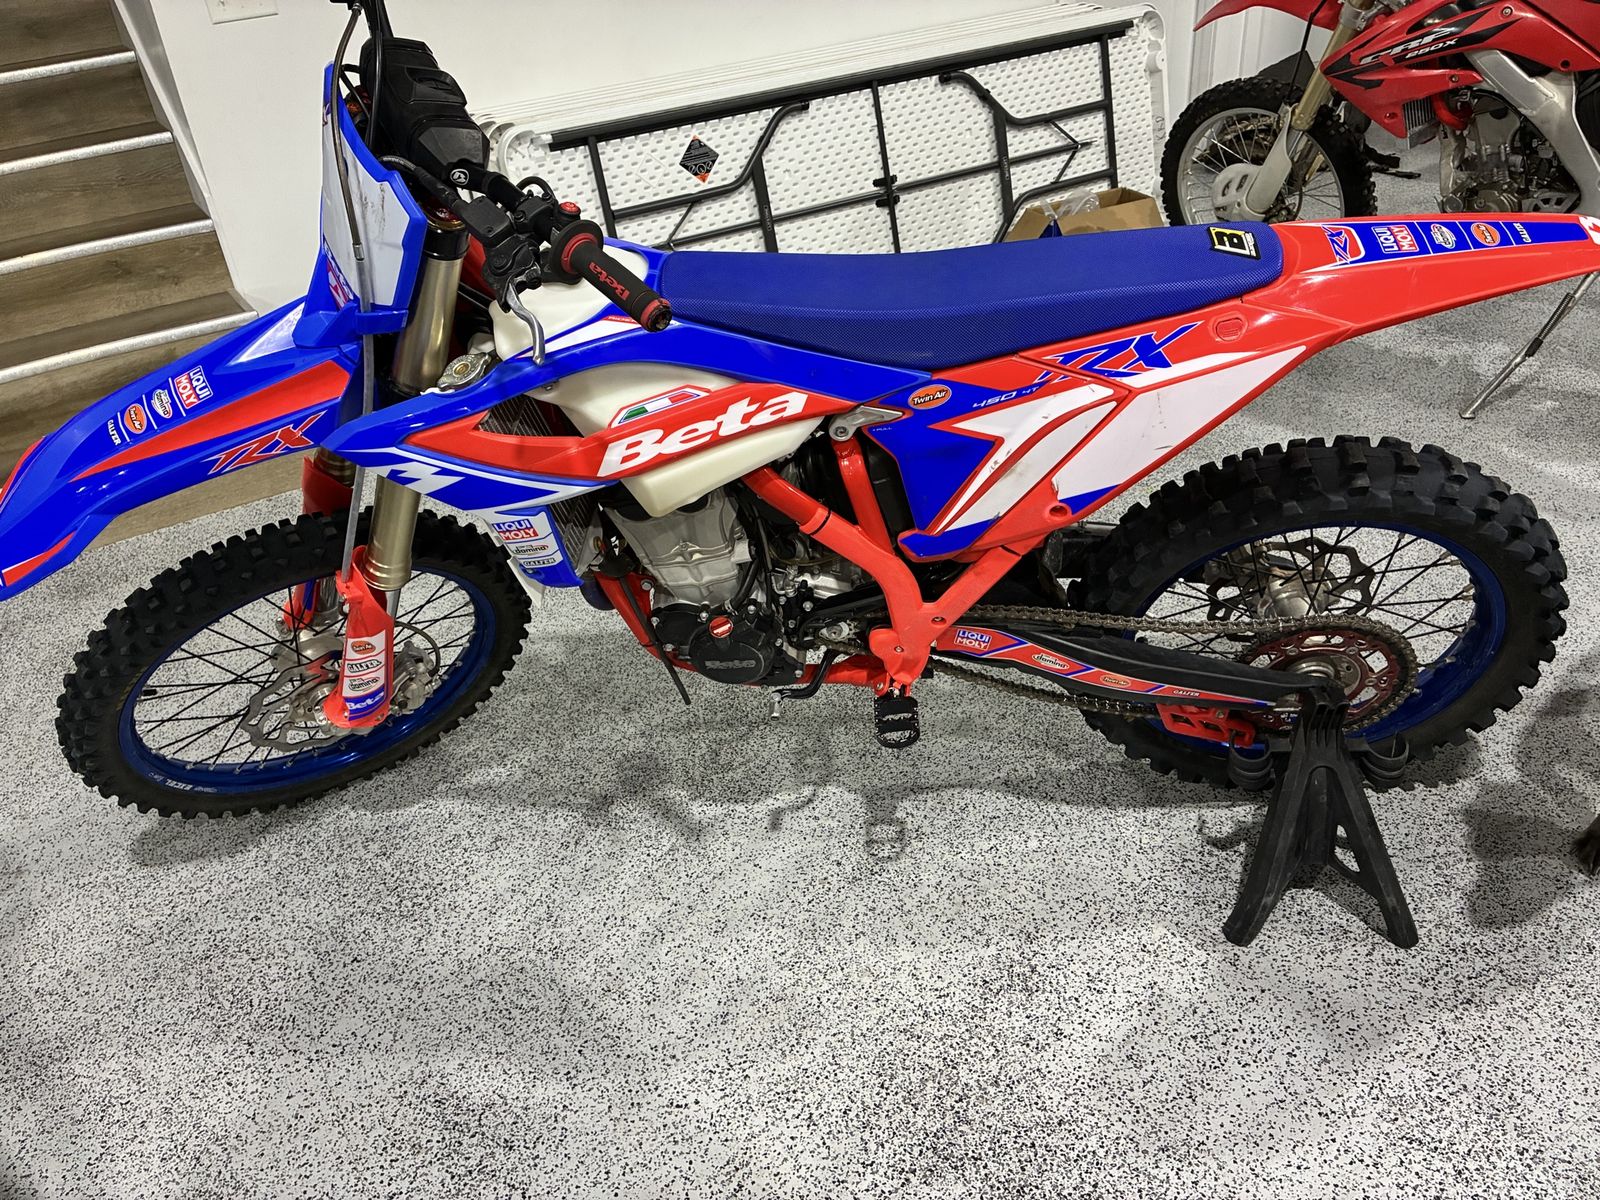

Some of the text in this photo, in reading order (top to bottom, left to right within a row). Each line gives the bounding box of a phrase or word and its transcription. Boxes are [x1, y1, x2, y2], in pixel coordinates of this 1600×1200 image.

[1405, 38, 1458, 58] 250X
[1374, 227, 1399, 251] LIQUI
[1391, 227, 1417, 251] MOLY
[589, 262, 630, 300] Beta
[176, 373, 199, 406] MOLY
[190, 367, 211, 399] LIQUI
[912, 390, 948, 405] Twin Air
[972, 391, 1018, 408] 450
[597, 391, 808, 477] Beta
[494, 519, 531, 532] LIQUI
[499, 528, 535, 540] MOLY
[515, 545, 547, 554] domino
[956, 637, 988, 649] MOLY
[959, 629, 990, 643] LIQUI
[347, 659, 381, 672] GALFER
[1036, 653, 1066, 669] domino
[346, 692, 385, 710] Beta
